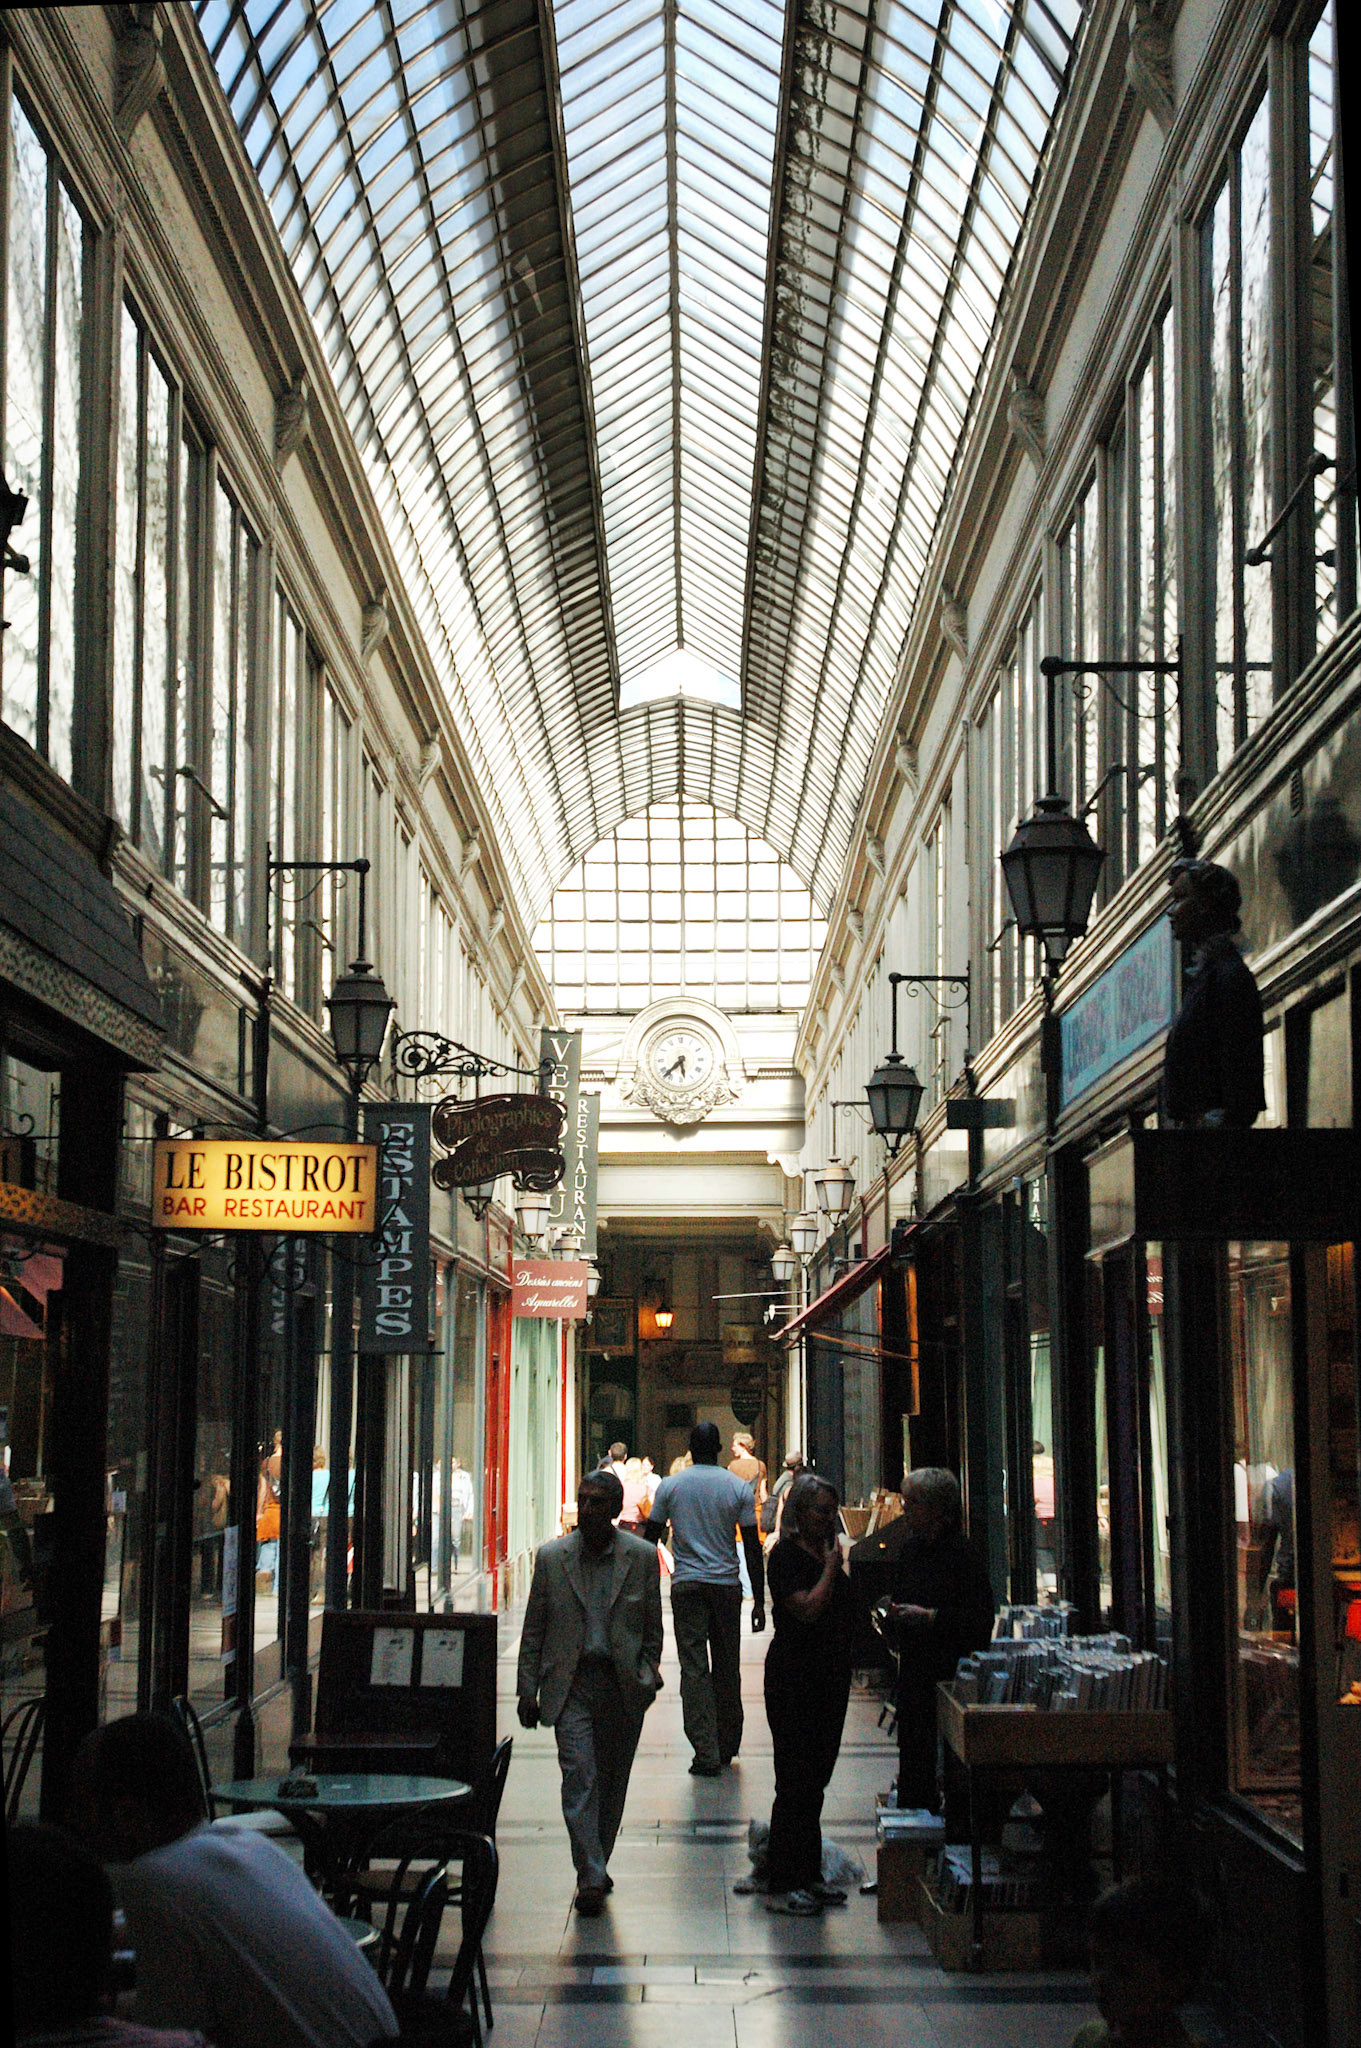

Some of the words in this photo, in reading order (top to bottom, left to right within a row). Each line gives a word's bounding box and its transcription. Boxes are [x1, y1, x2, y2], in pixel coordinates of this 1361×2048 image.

[447, 1103, 553, 1137] Photographies
[165, 1151, 205, 1189] LE
[224, 1153, 368, 1193] BISTROT
[573, 1099, 590, 1250] RESTAURANT
[162, 1197, 207, 1216] BAR
[224, 1199, 366, 1219] RESTAURANT
[375, 1123, 415, 1336] ESTAMPES
[515, 1271, 551, 1287] Dessins
[551, 1277, 583, 1288] anciens
[521, 1293, 579, 1312] Aquarelles
